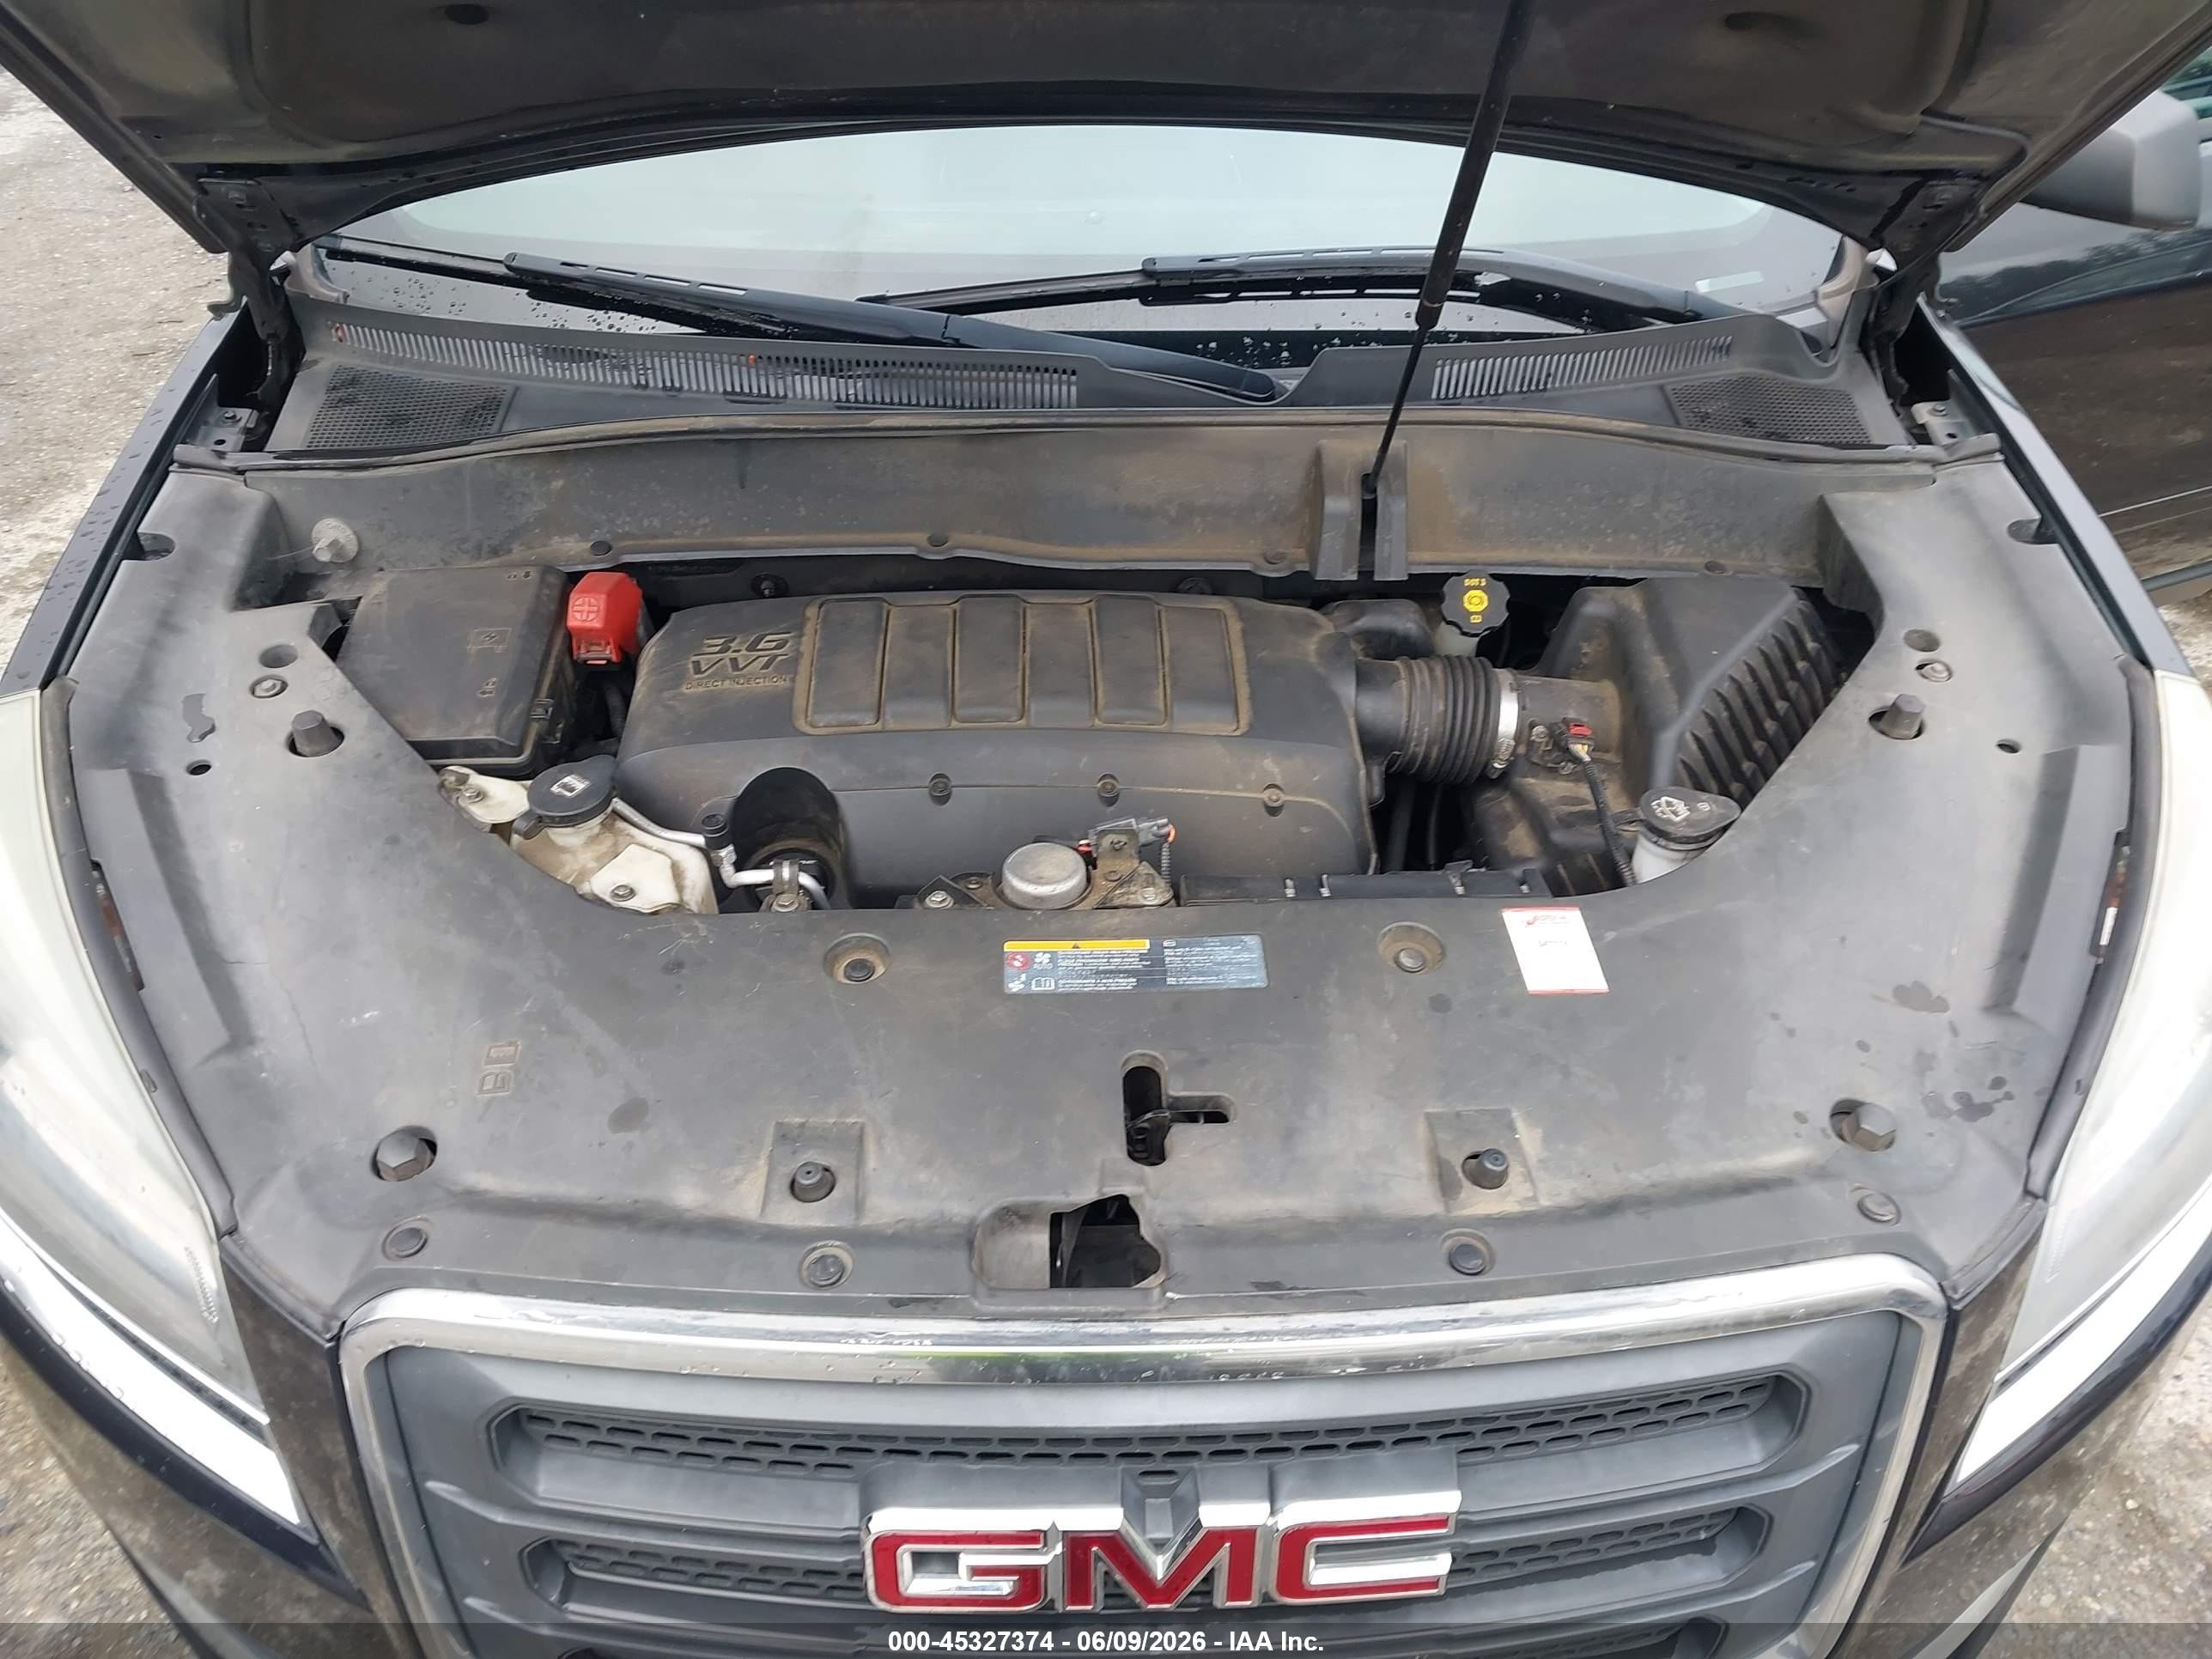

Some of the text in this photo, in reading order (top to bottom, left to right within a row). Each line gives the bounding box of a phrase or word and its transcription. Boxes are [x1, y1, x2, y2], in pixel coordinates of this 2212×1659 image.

[693, 631, 793, 656] 3.6
[691, 653, 789, 677] VVT
[865, 1491, 1462, 1613] GMC
